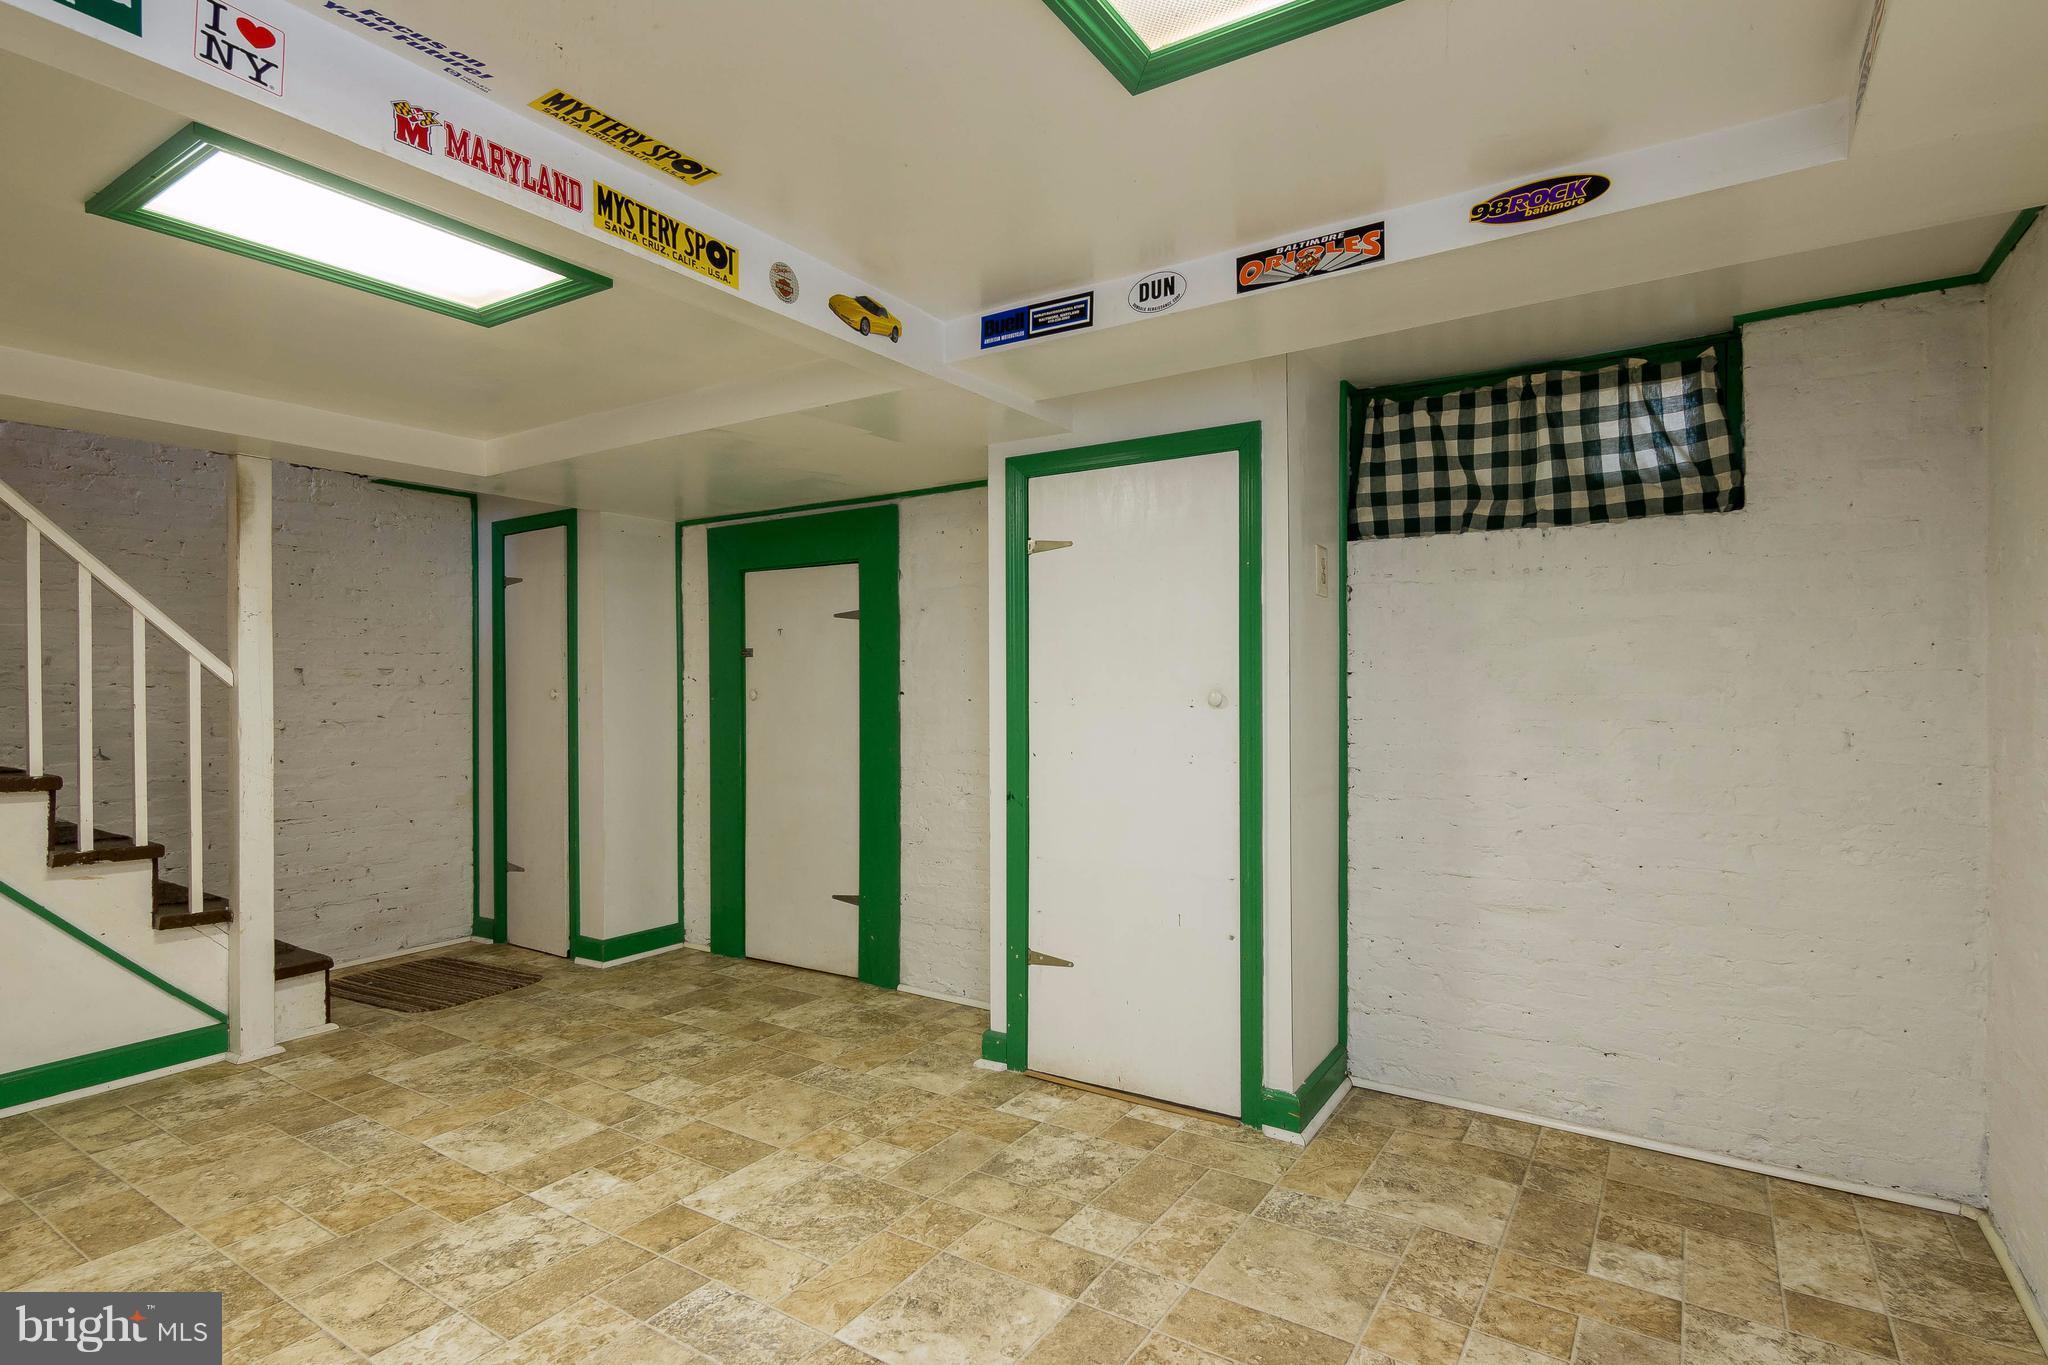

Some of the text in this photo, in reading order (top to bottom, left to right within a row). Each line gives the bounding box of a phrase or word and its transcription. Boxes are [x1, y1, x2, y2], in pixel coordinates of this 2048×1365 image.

[205, 0, 228, 36] I
[323, 0, 494, 79] Your Future!
[359, 9, 487, 67] Focus on
[199, 30, 279, 87] NY
[541, 92, 718, 180] MYSTERY SPOT
[542, 107, 582, 129] SANTA
[444, 120, 584, 213] MARYLAND
[597, 184, 736, 275] MYSTERY SPOT
[1524, 198, 1585, 217] baltimore
[604, 220, 732, 284] SANTA CRUZ, CALIF. U.S.A.
[1239, 229, 1381, 286] ORIOLES
[1275, 231, 1345, 254] BALTIMORE
[1139, 275, 1175, 303] DUN
